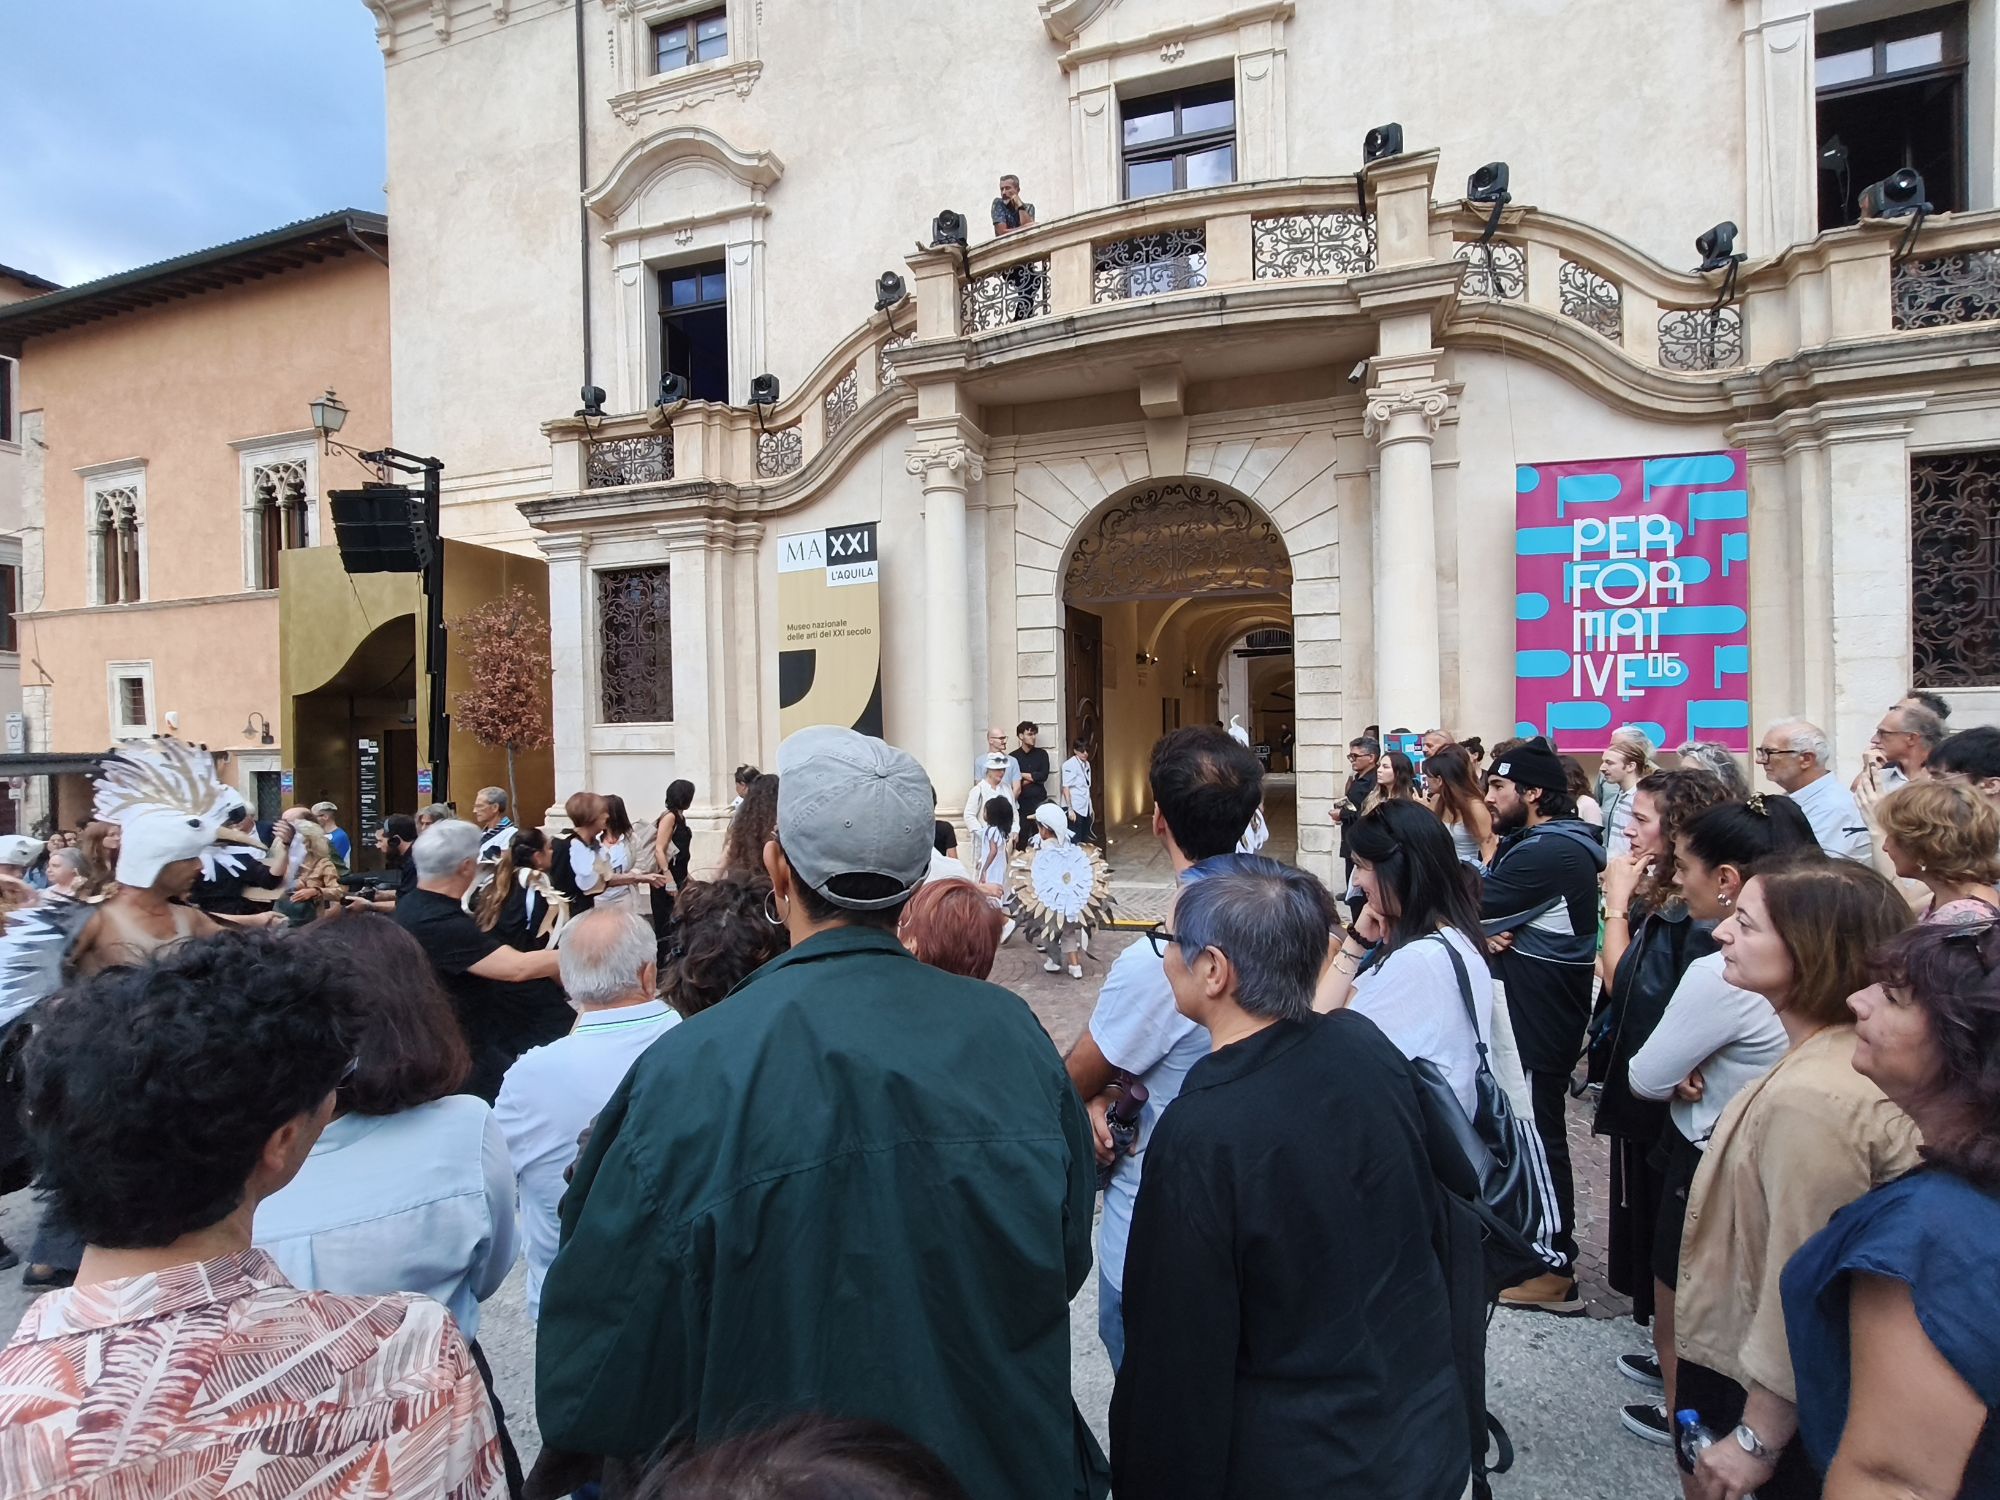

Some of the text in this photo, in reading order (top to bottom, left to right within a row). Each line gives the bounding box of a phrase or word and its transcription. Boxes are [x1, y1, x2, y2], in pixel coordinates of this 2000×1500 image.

[1573, 514, 1674, 561] PER
[831, 567, 873, 581] L'AQUILA
[1573, 560, 1683, 607] FOR
[787, 626, 872, 641] delle arti del XXI secolo
[812, 619, 847, 629] nazionale
[1573, 607, 1668, 652] MAT
[1573, 653, 1645, 697] IVE
